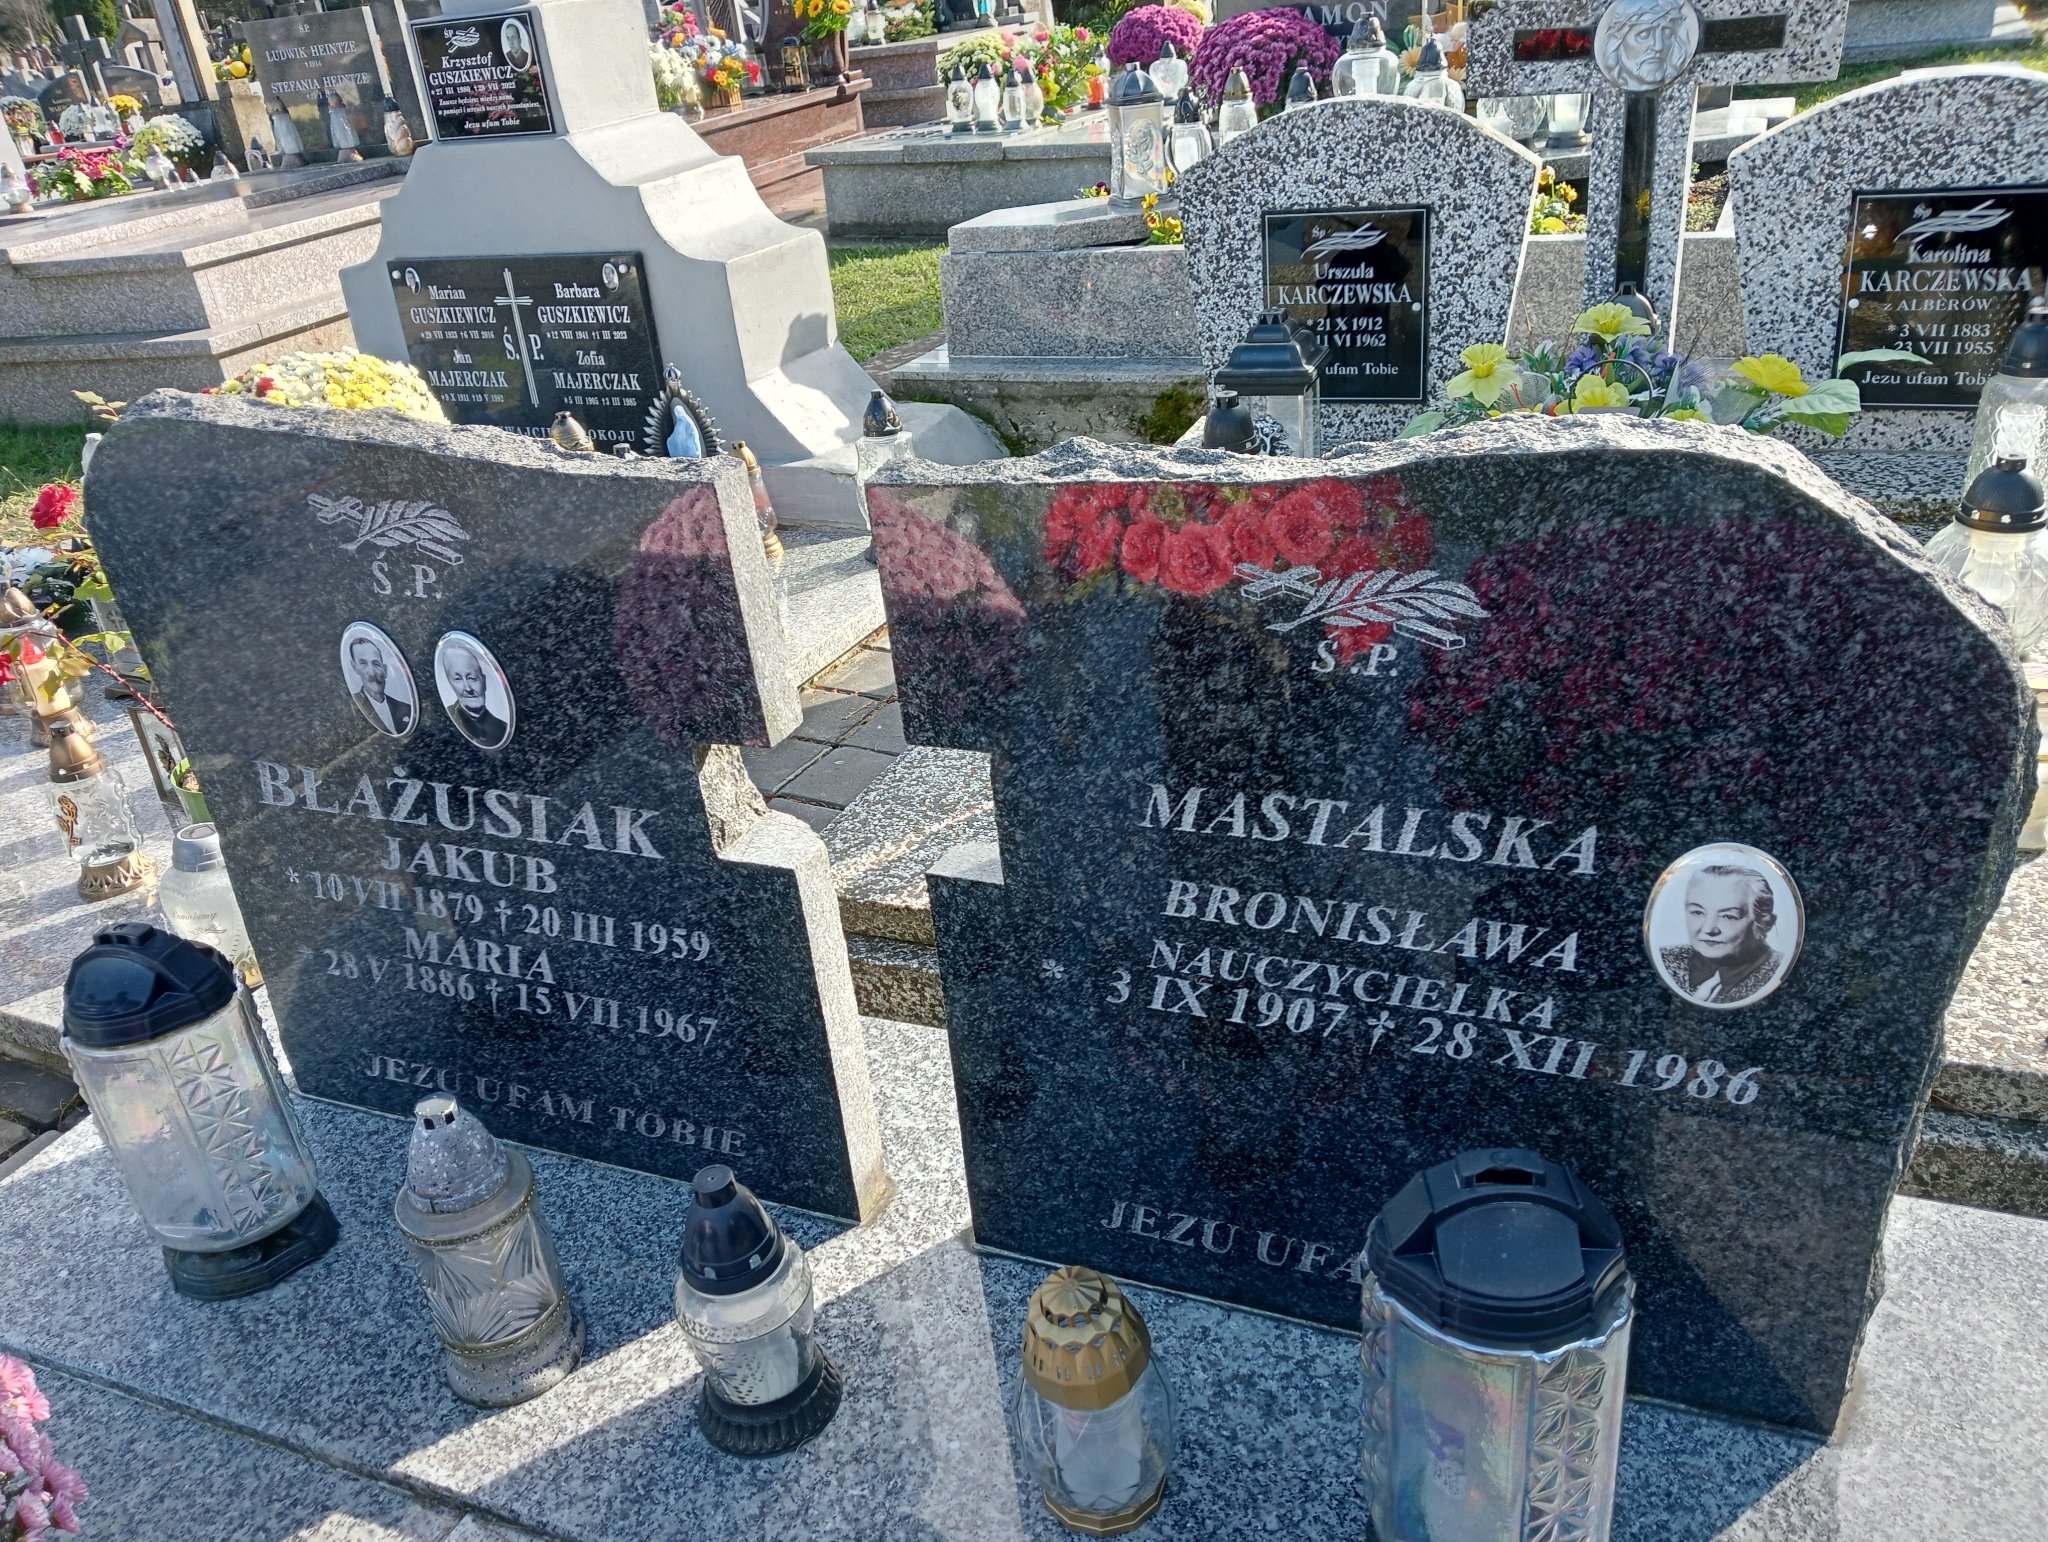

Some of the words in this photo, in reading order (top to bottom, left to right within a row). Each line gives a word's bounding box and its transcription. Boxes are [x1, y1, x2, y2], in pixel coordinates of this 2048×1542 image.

[265, 46, 308, 62] LUDWIK
[310, 40, 357, 57] HEINTZE
[441, 51, 493, 69] Krzysztof
[270, 78, 320, 94] STEFANIA
[322, 72, 370, 88] HEINTZE
[429, 65, 514, 86] GUSZKIEWICZ
[464, 120, 481, 129] Jezu
[481, 119, 501, 129] ufam
[501, 117, 520, 127] Tobie
[1906, 242, 1991, 264] Karolina
[1314, 262, 1374, 280] Urszula
[1860, 267, 2033, 292] KARCZEWSKA
[427, 285, 466, 300] Marian
[554, 283, 601, 299] Barbara
[1278, 283, 1413, 305] KARCZEWSKA
[1897, 296, 1993, 312] ALBERÓW
[410, 306, 497, 324] GUSZKIEWICZ
[537, 305, 631, 324] GUSZKIEWICZ
[1334, 317, 1348, 331] X
[1352, 316, 1383, 331] 1912
[433, 330, 443, 339] VII
[469, 330, 480, 339] VII
[560, 330, 573, 340] VIII
[575, 330, 589, 340] 1941
[602, 330, 611, 340] III
[613, 330, 628, 340] 2023
[1917, 324, 1946, 337] VII
[1952, 324, 1991, 337] 1883
[1333, 333, 1351, 347] VI
[1356, 333, 1387, 347] 1962
[1920, 341, 1949, 355] VII
[1954, 341, 1995, 355] 1955
[453, 349, 472, 364] Jan
[576, 350, 606, 366] Zofia
[1325, 362, 1358, 375] ufam
[1362, 362, 1399, 375] Tobie
[1862, 370, 1901, 384] Jezu
[1906, 371, 1949, 385] ufam
[1955, 369, 1987, 385] Tob
[427, 370, 508, 388] MAJERCZAK
[552, 372, 642, 391] MAJERCZAK
[450, 393, 457, 402] X
[457, 394, 470, 402] 1911
[483, 394, 489, 402] V
[574, 396, 584, 405] III
[611, 397, 621, 406] III
[587, 428, 635, 442] OKOJU
[253, 759, 664, 861] BŁAŻUSIAK
[1138, 783, 1600, 876] MASTALSKA
[381, 836, 558, 894] JAKUB
[308, 870, 344, 901] 10
[350, 875, 403, 912] VII
[412, 886, 484, 924] 1879
[522, 903, 561, 937] 20
[571, 911, 617, 947] III
[630, 921, 711, 961] 1959
[1160, 879, 1581, 972] BRONISŁAWA
[402, 926, 556, 984] MARIA
[1146, 940, 1557, 1030] NAUCZYCIELKA
[323, 950, 358, 979] 28
[366, 955, 391, 983] V
[401, 963, 476, 1001] 1886
[516, 983, 551, 1015] 15
[562, 990, 621, 1029] VII
[636, 1005, 718, 1045] 1967
[1106, 968, 1132, 1004] 3
[1147, 975, 1210, 1018] IX
[1231, 988, 1350, 1040] 1907
[1411, 1017, 1477, 1061] 28
[1494, 1029, 1601, 1080] XII
[1613, 1049, 1766, 1105] 1986
[365, 1055, 460, 1092] JEZU
[474, 1075, 596, 1125] UFAM
[609, 1105, 748, 1158] TOBIE
[1101, 1199, 1241, 1255] JEZU
[1256, 1229, 1362, 1284] UFA
